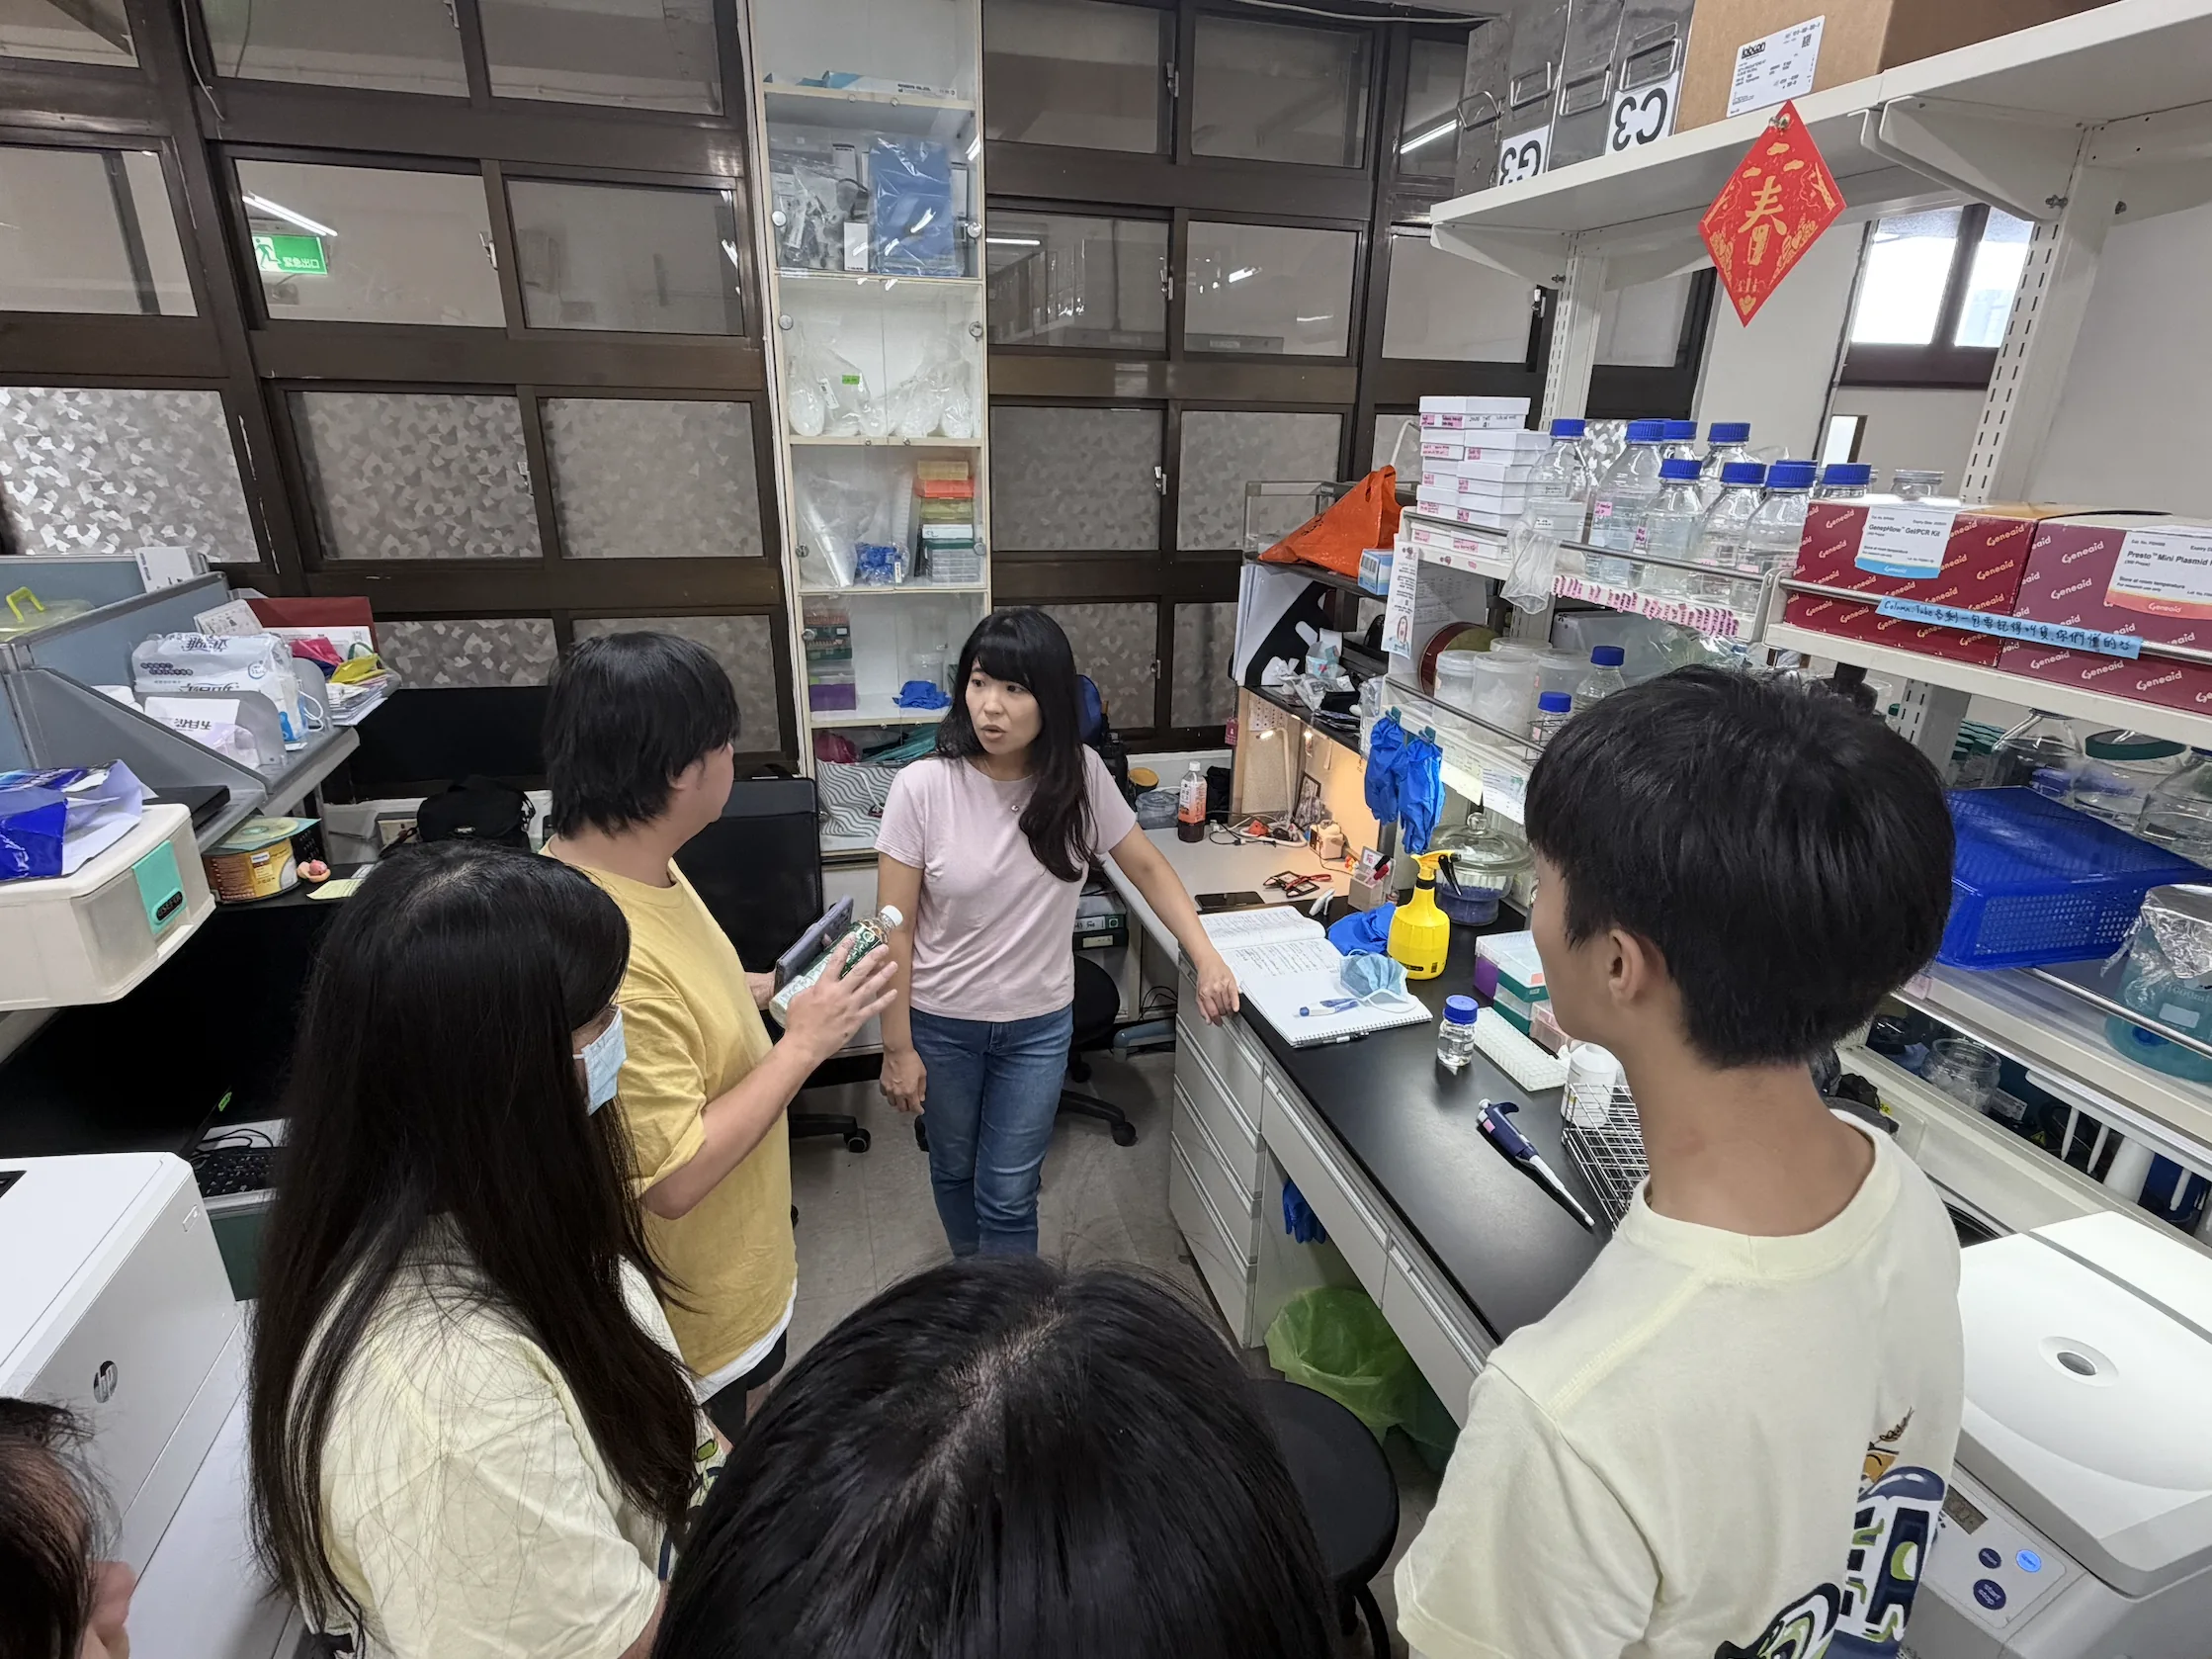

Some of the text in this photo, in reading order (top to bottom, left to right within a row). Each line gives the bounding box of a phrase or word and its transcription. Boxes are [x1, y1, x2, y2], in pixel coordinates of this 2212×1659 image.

[1613, 87, 1668, 151] C3
[1738, 176, 1788, 266] 春
[283, 256, 320, 269] 緊急出口
[1826, 508, 1854, 529] Geneaid
[1949, 521, 1978, 538] eneaid
[1987, 524, 2025, 547] Geneaid
[1819, 539, 1847, 559] Geneaid
[2062, 541, 2104, 565] Geneaid
[1940, 554, 1968, 571] eneaid
[1977, 560, 2014, 580] Geneaid
[2175, 556, 2208, 566] Plasmid
[2050, 577, 2092, 599] Geneaid
[1806, 600, 1832, 616] Geneaid
[1840, 606, 1869, 623] Geneaid
[2148, 602, 2182, 613] Geneaid
[2030, 651, 2071, 669] Geneaid
[2081, 660, 2124, 680] Geneaid
[2136, 670, 2182, 691] Geneaid
[1978, 1589, 1995, 1606] stop
[1984, 1584, 2001, 1600] start
